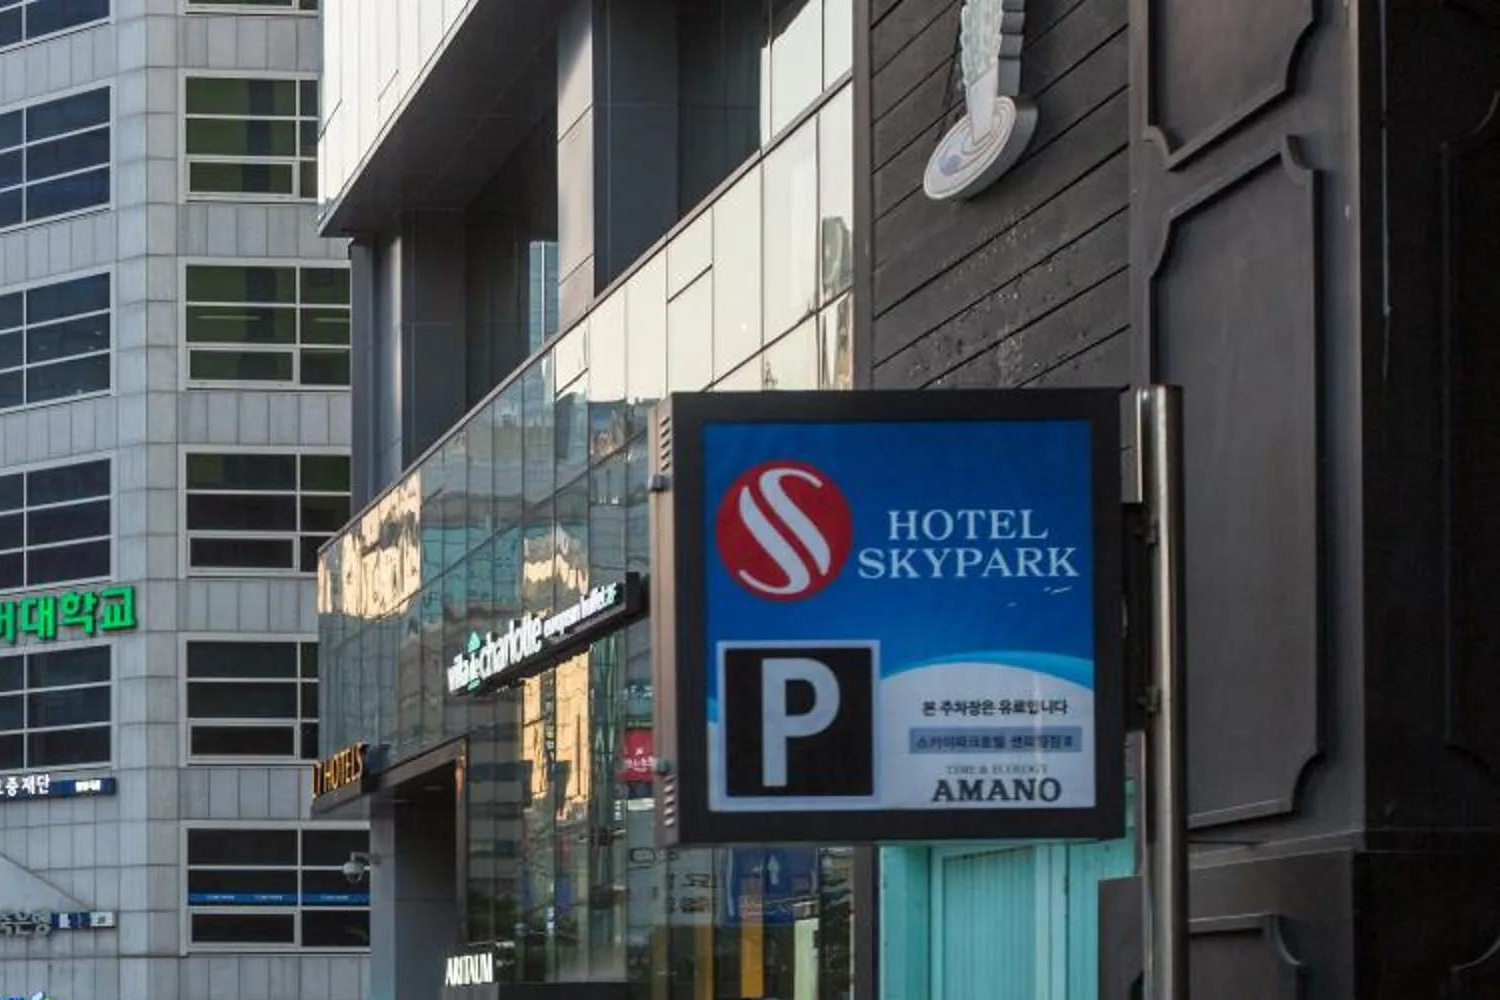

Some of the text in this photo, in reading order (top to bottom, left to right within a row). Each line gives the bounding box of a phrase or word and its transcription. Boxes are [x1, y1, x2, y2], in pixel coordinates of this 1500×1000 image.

[888, 509, 1049, 540] HOTEL
[857, 546, 1080, 579] SKYPARK
[761, 657, 841, 787] P
[932, 777, 1062, 803] AMANO
